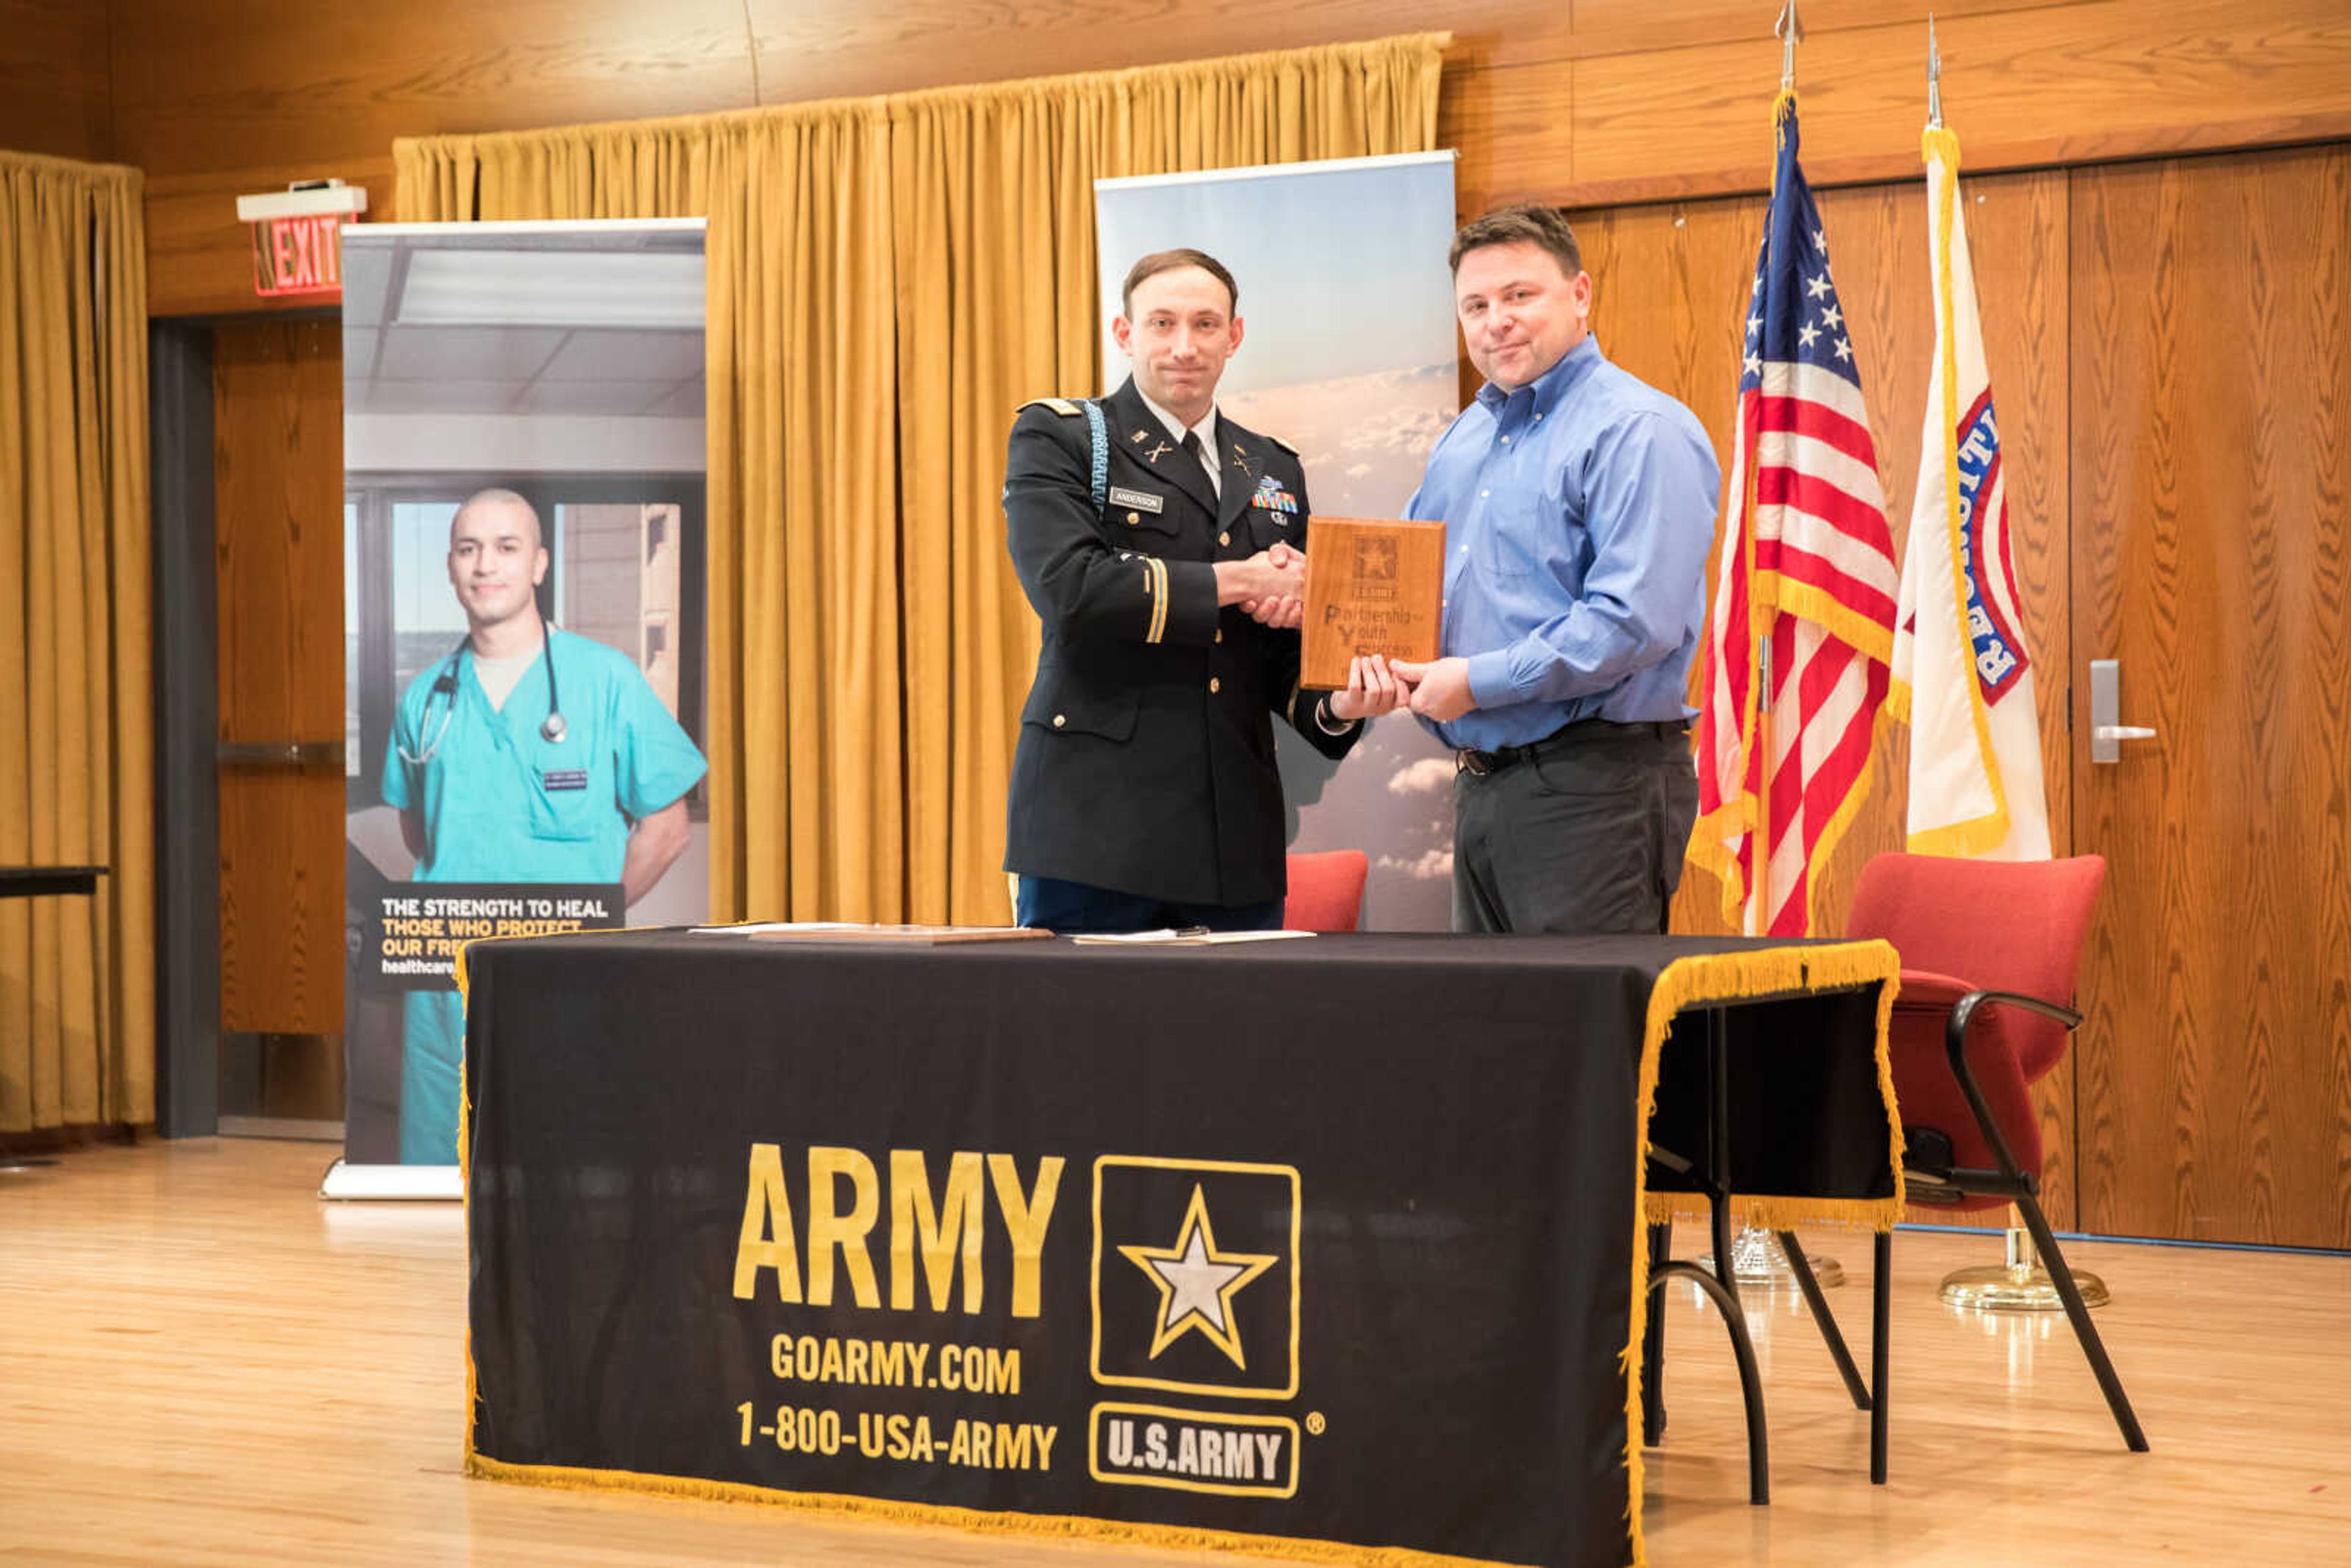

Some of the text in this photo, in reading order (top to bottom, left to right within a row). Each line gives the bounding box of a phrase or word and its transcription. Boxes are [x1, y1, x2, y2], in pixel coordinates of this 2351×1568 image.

[272, 219, 337, 287] EXIT
[1116, 492, 1158, 508] ANDERSON
[1324, 603, 1411, 624] Partnership
[1338, 625, 1387, 647] Youth
[382, 899, 609, 918] THE STRENGTH TO HEAL
[382, 919, 582, 936] THOSE WHO PROTECT
[382, 939, 422, 956] OUR
[733, 1142, 1066, 1318] ARMY
[771, 1334, 1021, 1395] GOARMY.COM
[737, 1401, 1057, 1471] 1-800-USA-ARMY
[1107, 1419, 1282, 1480] U.S.ARMY
